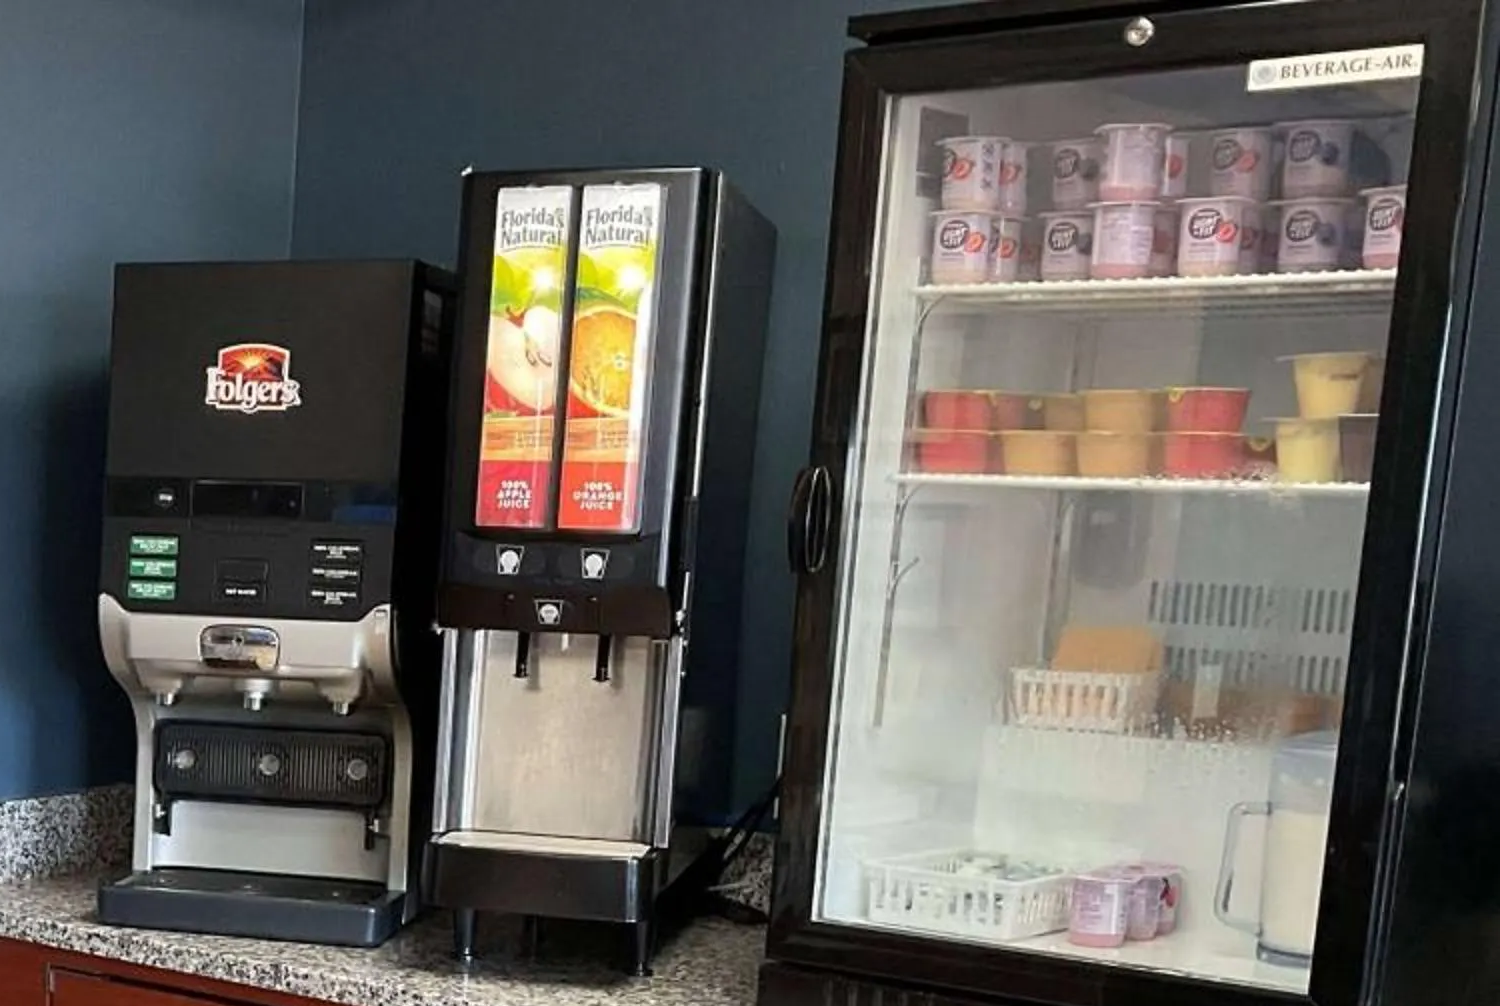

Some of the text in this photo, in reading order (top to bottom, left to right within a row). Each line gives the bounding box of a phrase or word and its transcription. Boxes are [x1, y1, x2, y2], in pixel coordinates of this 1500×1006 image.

[1280, 53, 1413, 79] BEVERAGE-AIR
[502, 207, 564, 229] Florida's
[587, 205, 653, 227] Florida's
[501, 226, 562, 249] Natural
[585, 224, 650, 247] Natural
[206, 367, 301, 413] Folgers
[501, 479, 529, 489] 100%
[583, 481, 612, 491] 100%
[497, 489, 532, 499] APPLE
[572, 490, 623, 501] ORANGE
[497, 499, 530, 509] JUICE
[579, 501, 613, 510] JUICE
